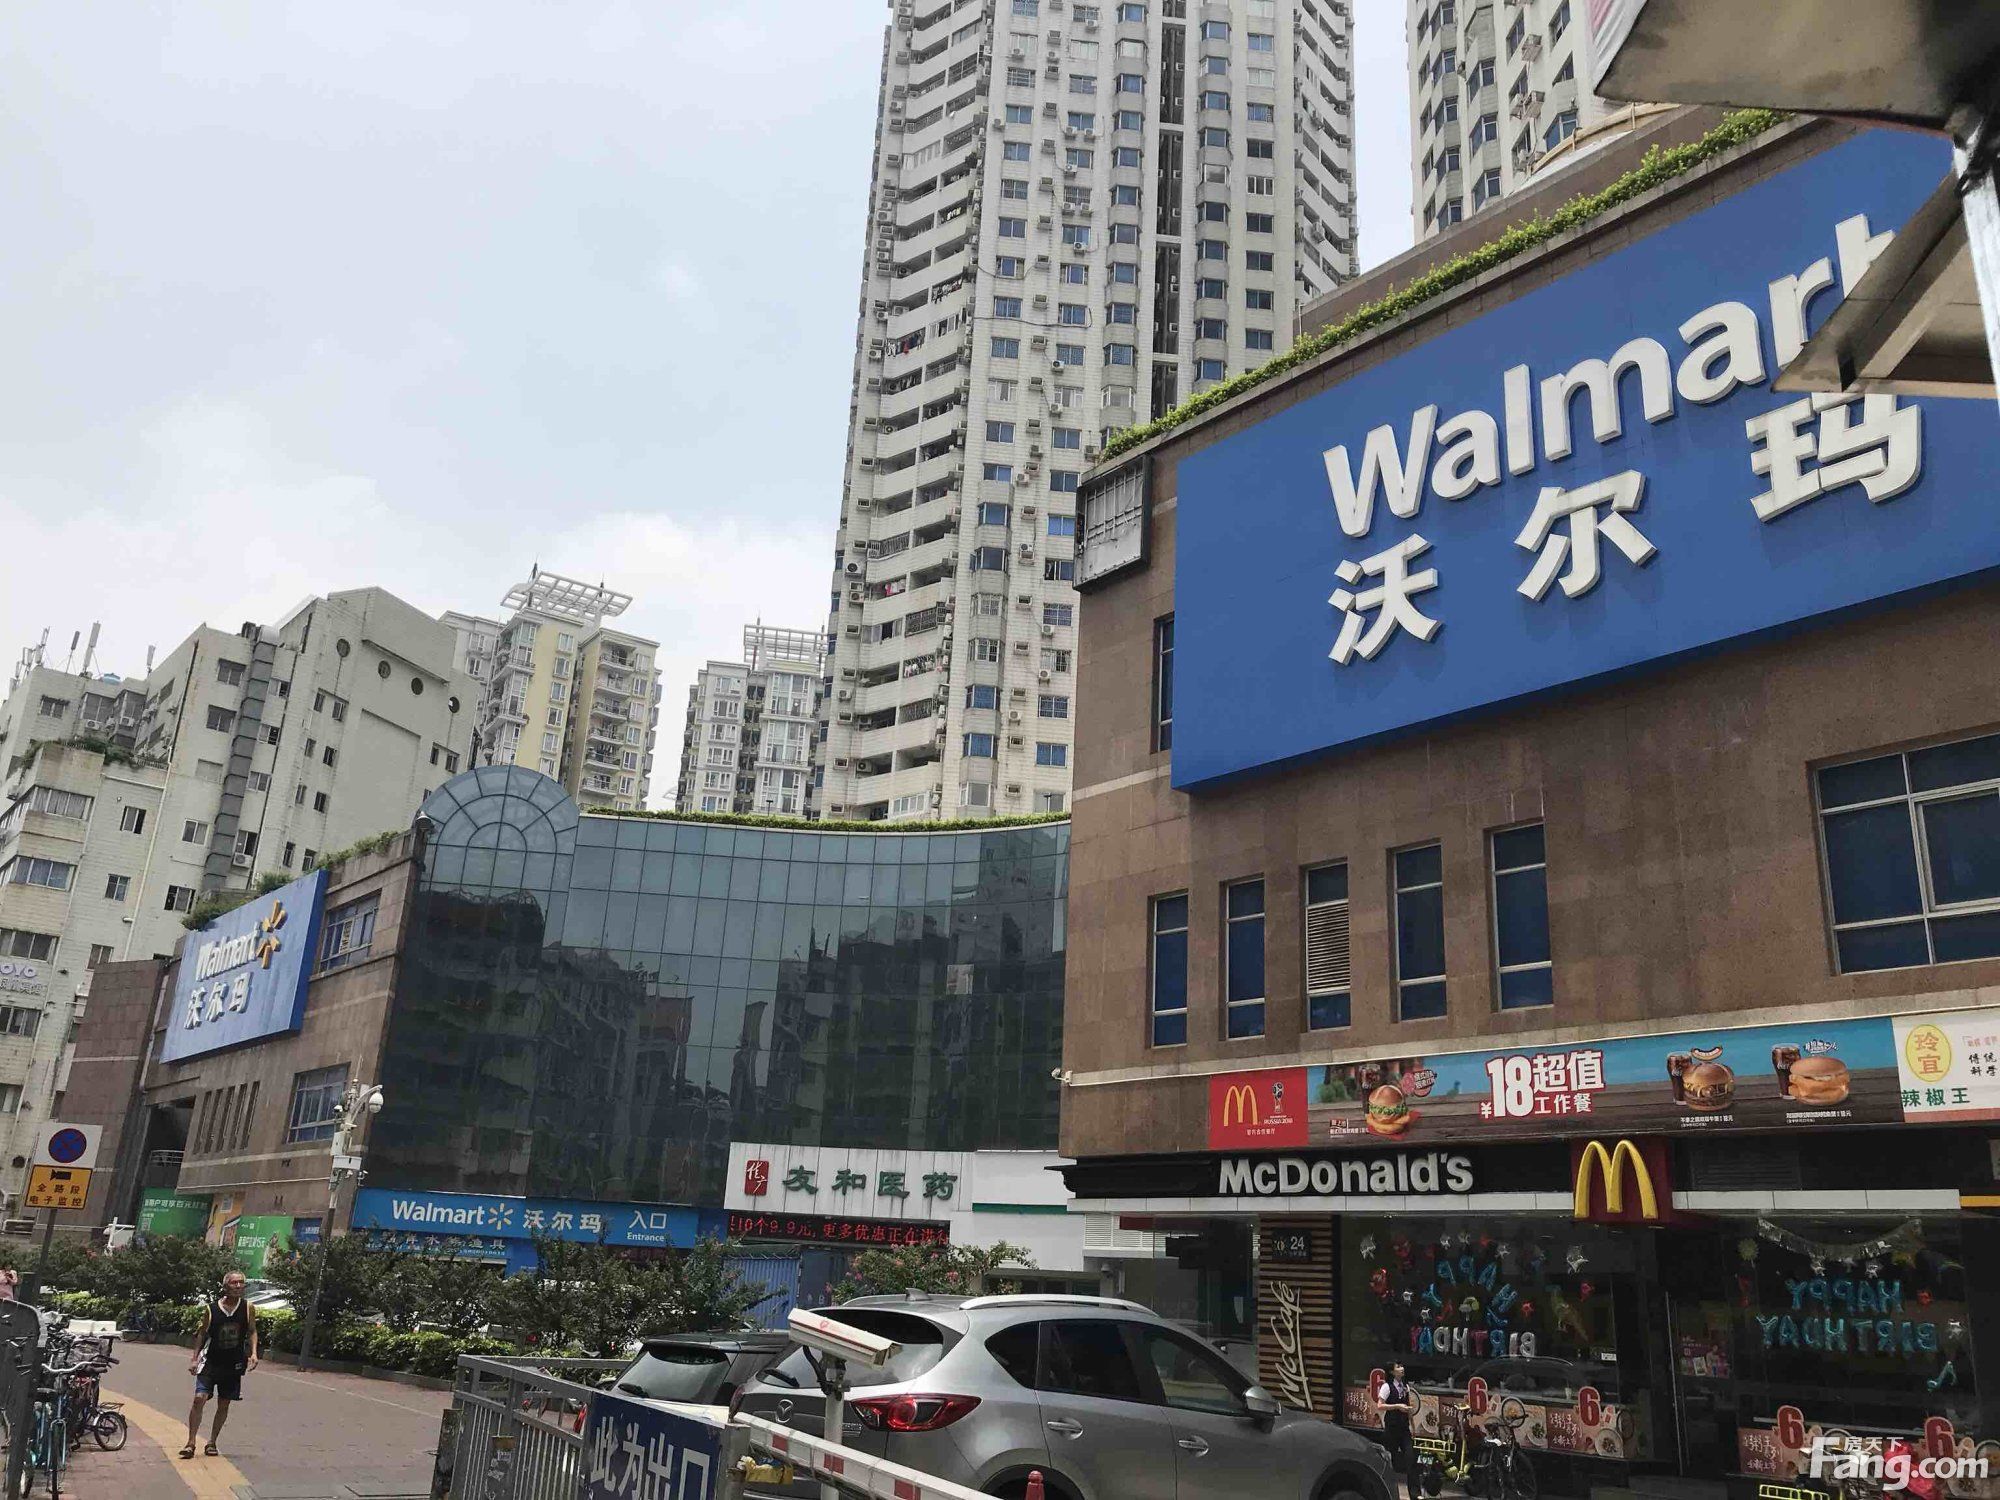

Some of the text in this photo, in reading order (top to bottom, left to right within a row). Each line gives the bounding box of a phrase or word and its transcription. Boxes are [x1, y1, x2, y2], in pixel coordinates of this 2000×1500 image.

[1328, 390, 1922, 666] 沃尔玛
[196, 921, 260, 982] Walmart
[184, 972, 252, 1030] 沃尔玛
[1532, 1050, 1606, 1095] 超值
[1534, 1091, 1593, 1116] 工作餐
[1902, 1087, 1970, 1108] 辣椒王
[36, 1183, 80, 1195] 全路段
[1219, 1153, 1474, 1196] McDonald's
[30, 1195, 82, 1207] 电子监控
[392, 1199, 485, 1226] Walmart
[523, 1209, 601, 1234] 沃尔玛
[629, 1210, 667, 1230] 入口
[626, 1231, 665, 1243] Entrance
[1579, 1386, 1601, 1426] 6
[1777, 1405, 1804, 1450] 6
[590, 1416, 710, 1500] 此为出口
